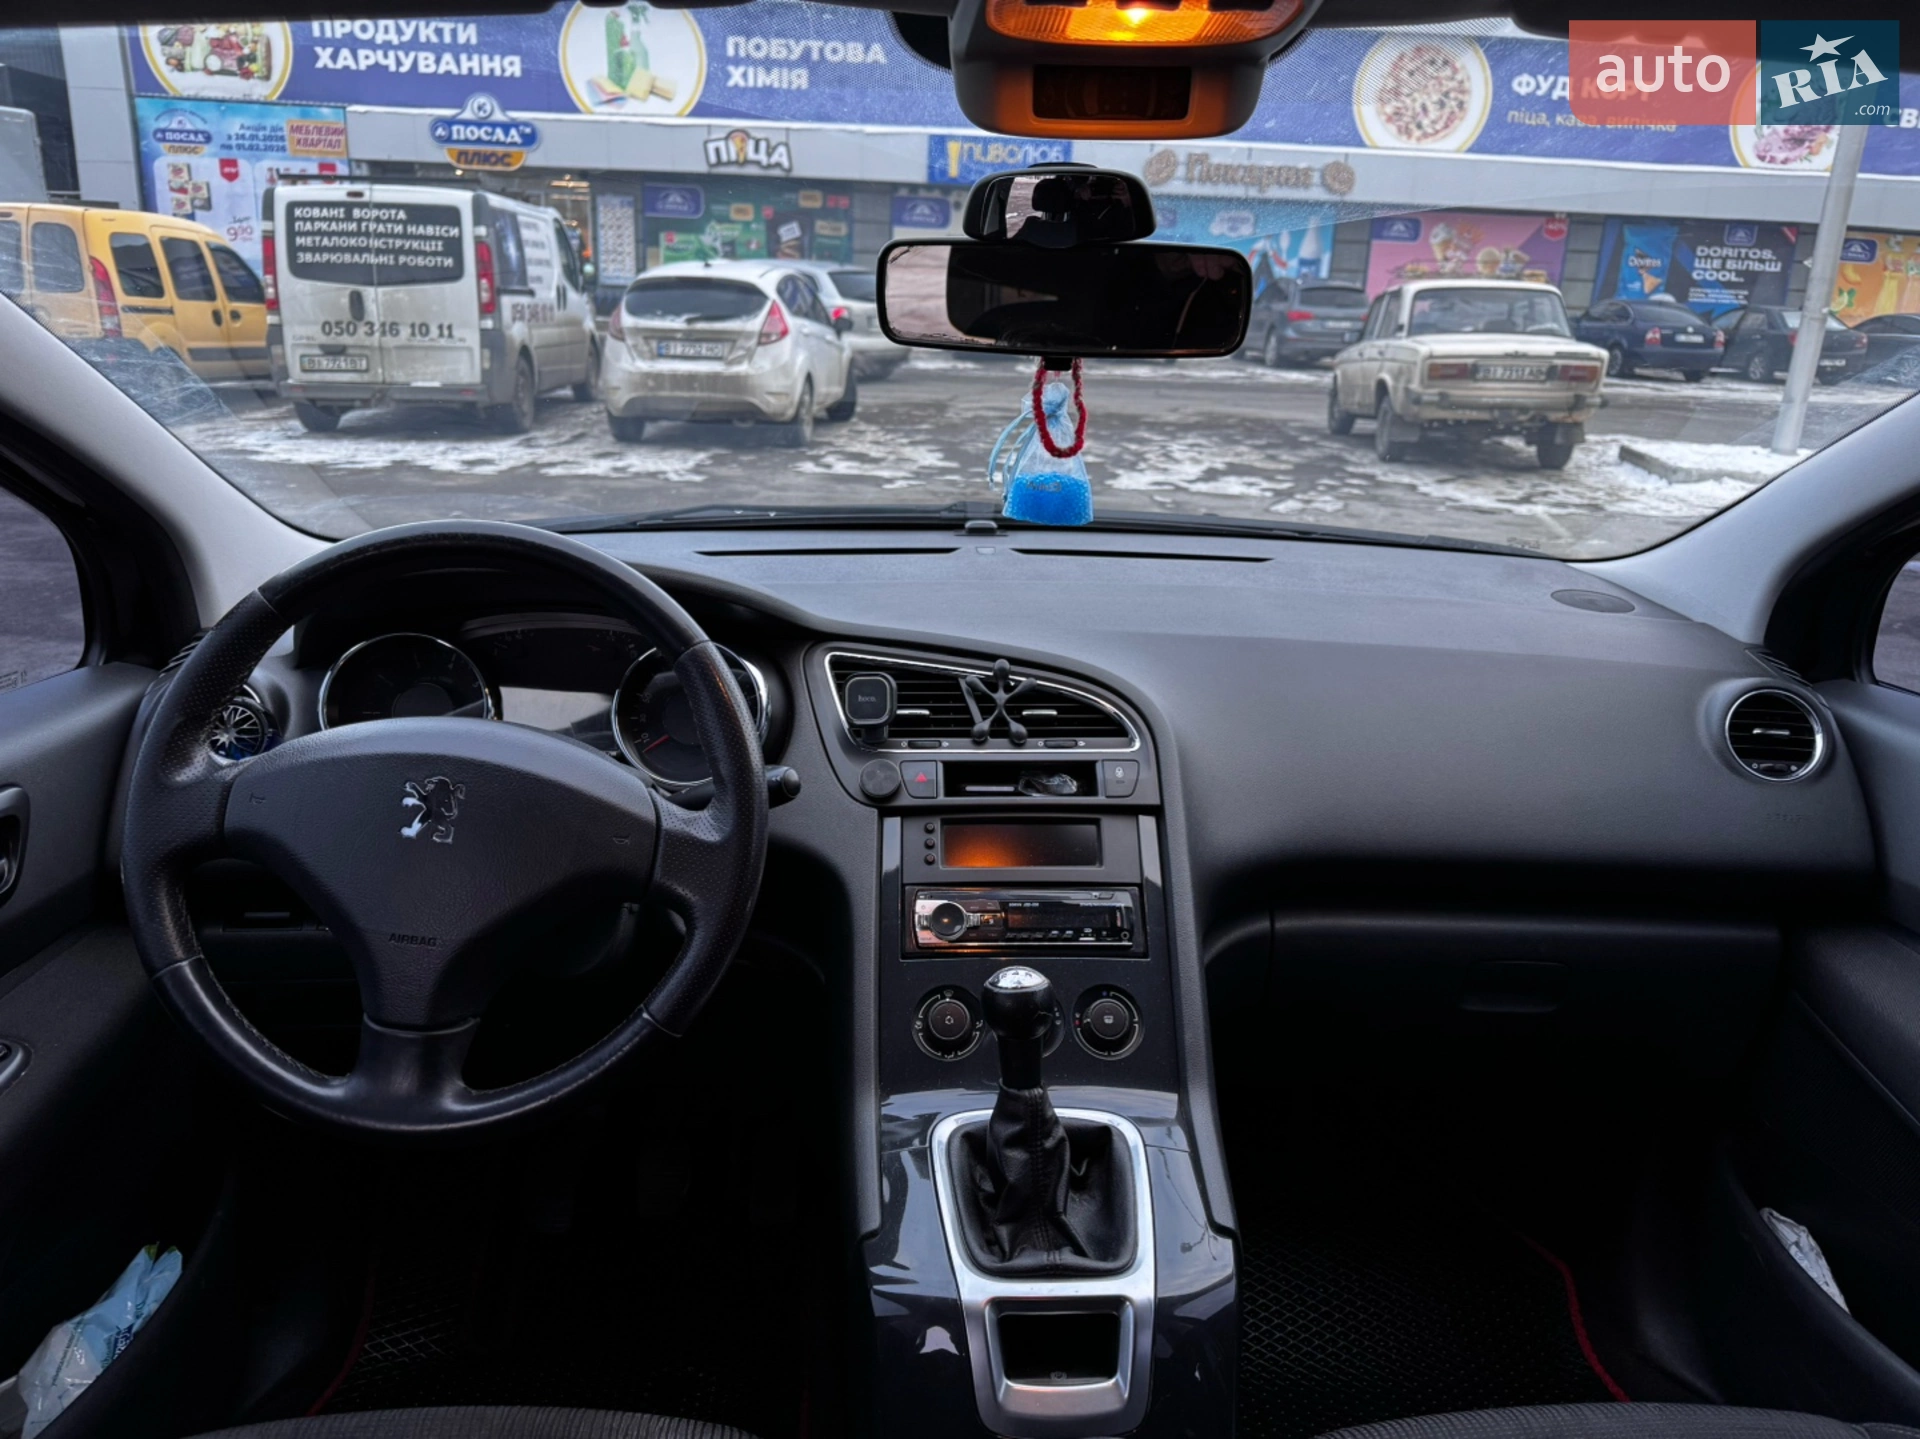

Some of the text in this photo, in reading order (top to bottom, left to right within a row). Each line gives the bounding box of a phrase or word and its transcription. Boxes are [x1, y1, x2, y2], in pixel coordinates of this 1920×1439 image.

[311, 18, 478, 45] ПРОДУКТИ
[726, 35, 888, 64] ПОБУТОВА
[313, 47, 522, 77] ХАРЧУВАННЯ
[726, 65, 809, 89] ХІМІЯ
[1511, 73, 1574, 100] ФУД
[1507, 108, 1550, 127] піца,
[1882, 108, 1920, 128] СВ
[450, 124, 522, 145] ПОСАД
[456, 150, 513, 167] ПЛЮС
[704, 129, 792, 172] ПІЦА
[294, 207, 407, 221] КОВАНІ ВОРОТА
[295, 221, 460, 239] ПАРКАНИ ГРАТИ НАВІСИ
[296, 252, 454, 267] ЗВАРЮВАЛЬНІ РОБОТИ
[1696, 245, 1777, 260] DORITOS.
[1725, 258, 1782, 272] БІЛЬШ
[1692, 269, 1745, 282] COOL.
[321, 321, 358, 337] 050
[408, 322, 430, 338] 10
[437, 323, 455, 339] 11
[388, 933, 437, 947] AIRBAG
